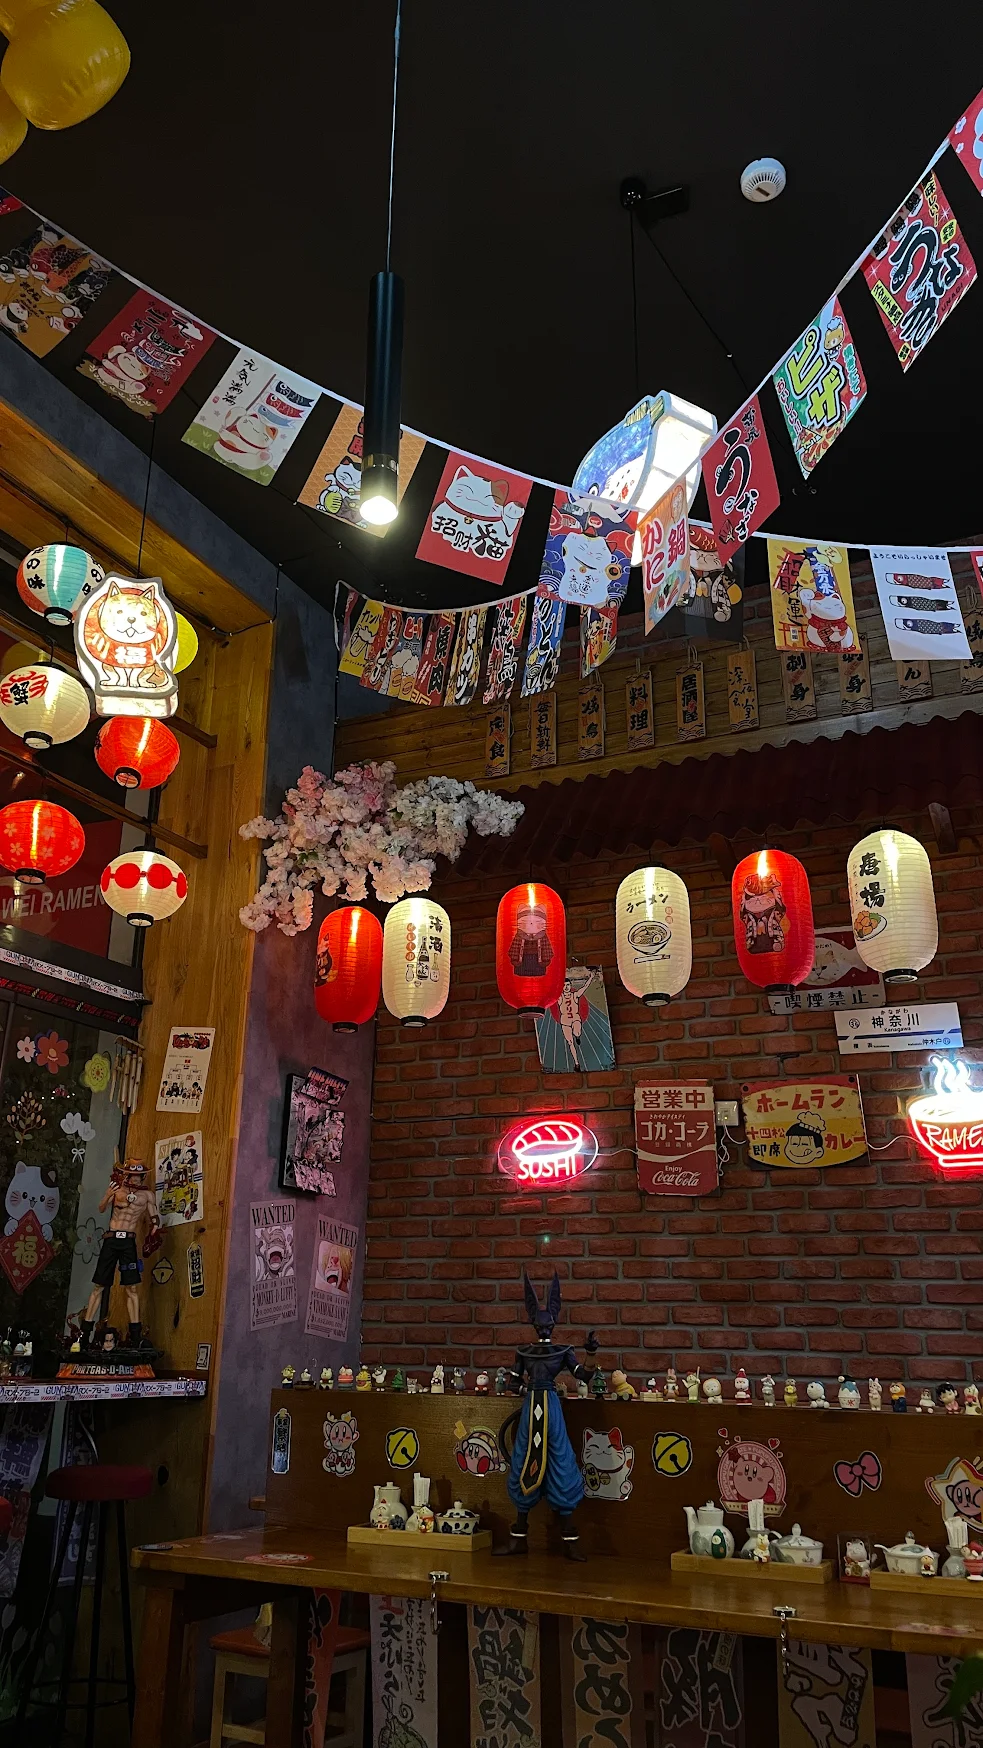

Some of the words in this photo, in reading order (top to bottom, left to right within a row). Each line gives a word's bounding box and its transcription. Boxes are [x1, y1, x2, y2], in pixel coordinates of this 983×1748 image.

[941, 283, 964, 312] UNAGI
[787, 329, 840, 421] ピザ
[642, 518, 665, 594] かに
[786, 653, 809, 701] 刺身
[582, 697, 600, 738] 焼鳥
[630, 684, 648, 731] 料理
[40, 884, 105, 914] RAMEN
[565, 1000, 574, 1018] グリコ
[785, 989, 869, 1009] 喫煙禁止
[871, 1013, 920, 1029] 神奈川
[880, 1008, 909, 1016] かながわ
[642, 1090, 706, 1109] 営業中
[757, 1089, 845, 1113] ホームラン
[641, 1121, 709, 1141] コカ・コーラ
[747, 1127, 785, 1140] 十四松
[825, 1133, 866, 1151] カレー
[922, 1123, 983, 1151] RAME
[753, 1142, 781, 1157] 即席
[518, 1156, 576, 1179] SUSHI
[652, 1170, 702, 1187] Coca-Cola
[665, 1165, 683, 1173] Enjoy
[252, 1204, 295, 1227] WANTED
[319, 1220, 357, 1248] WANTED
